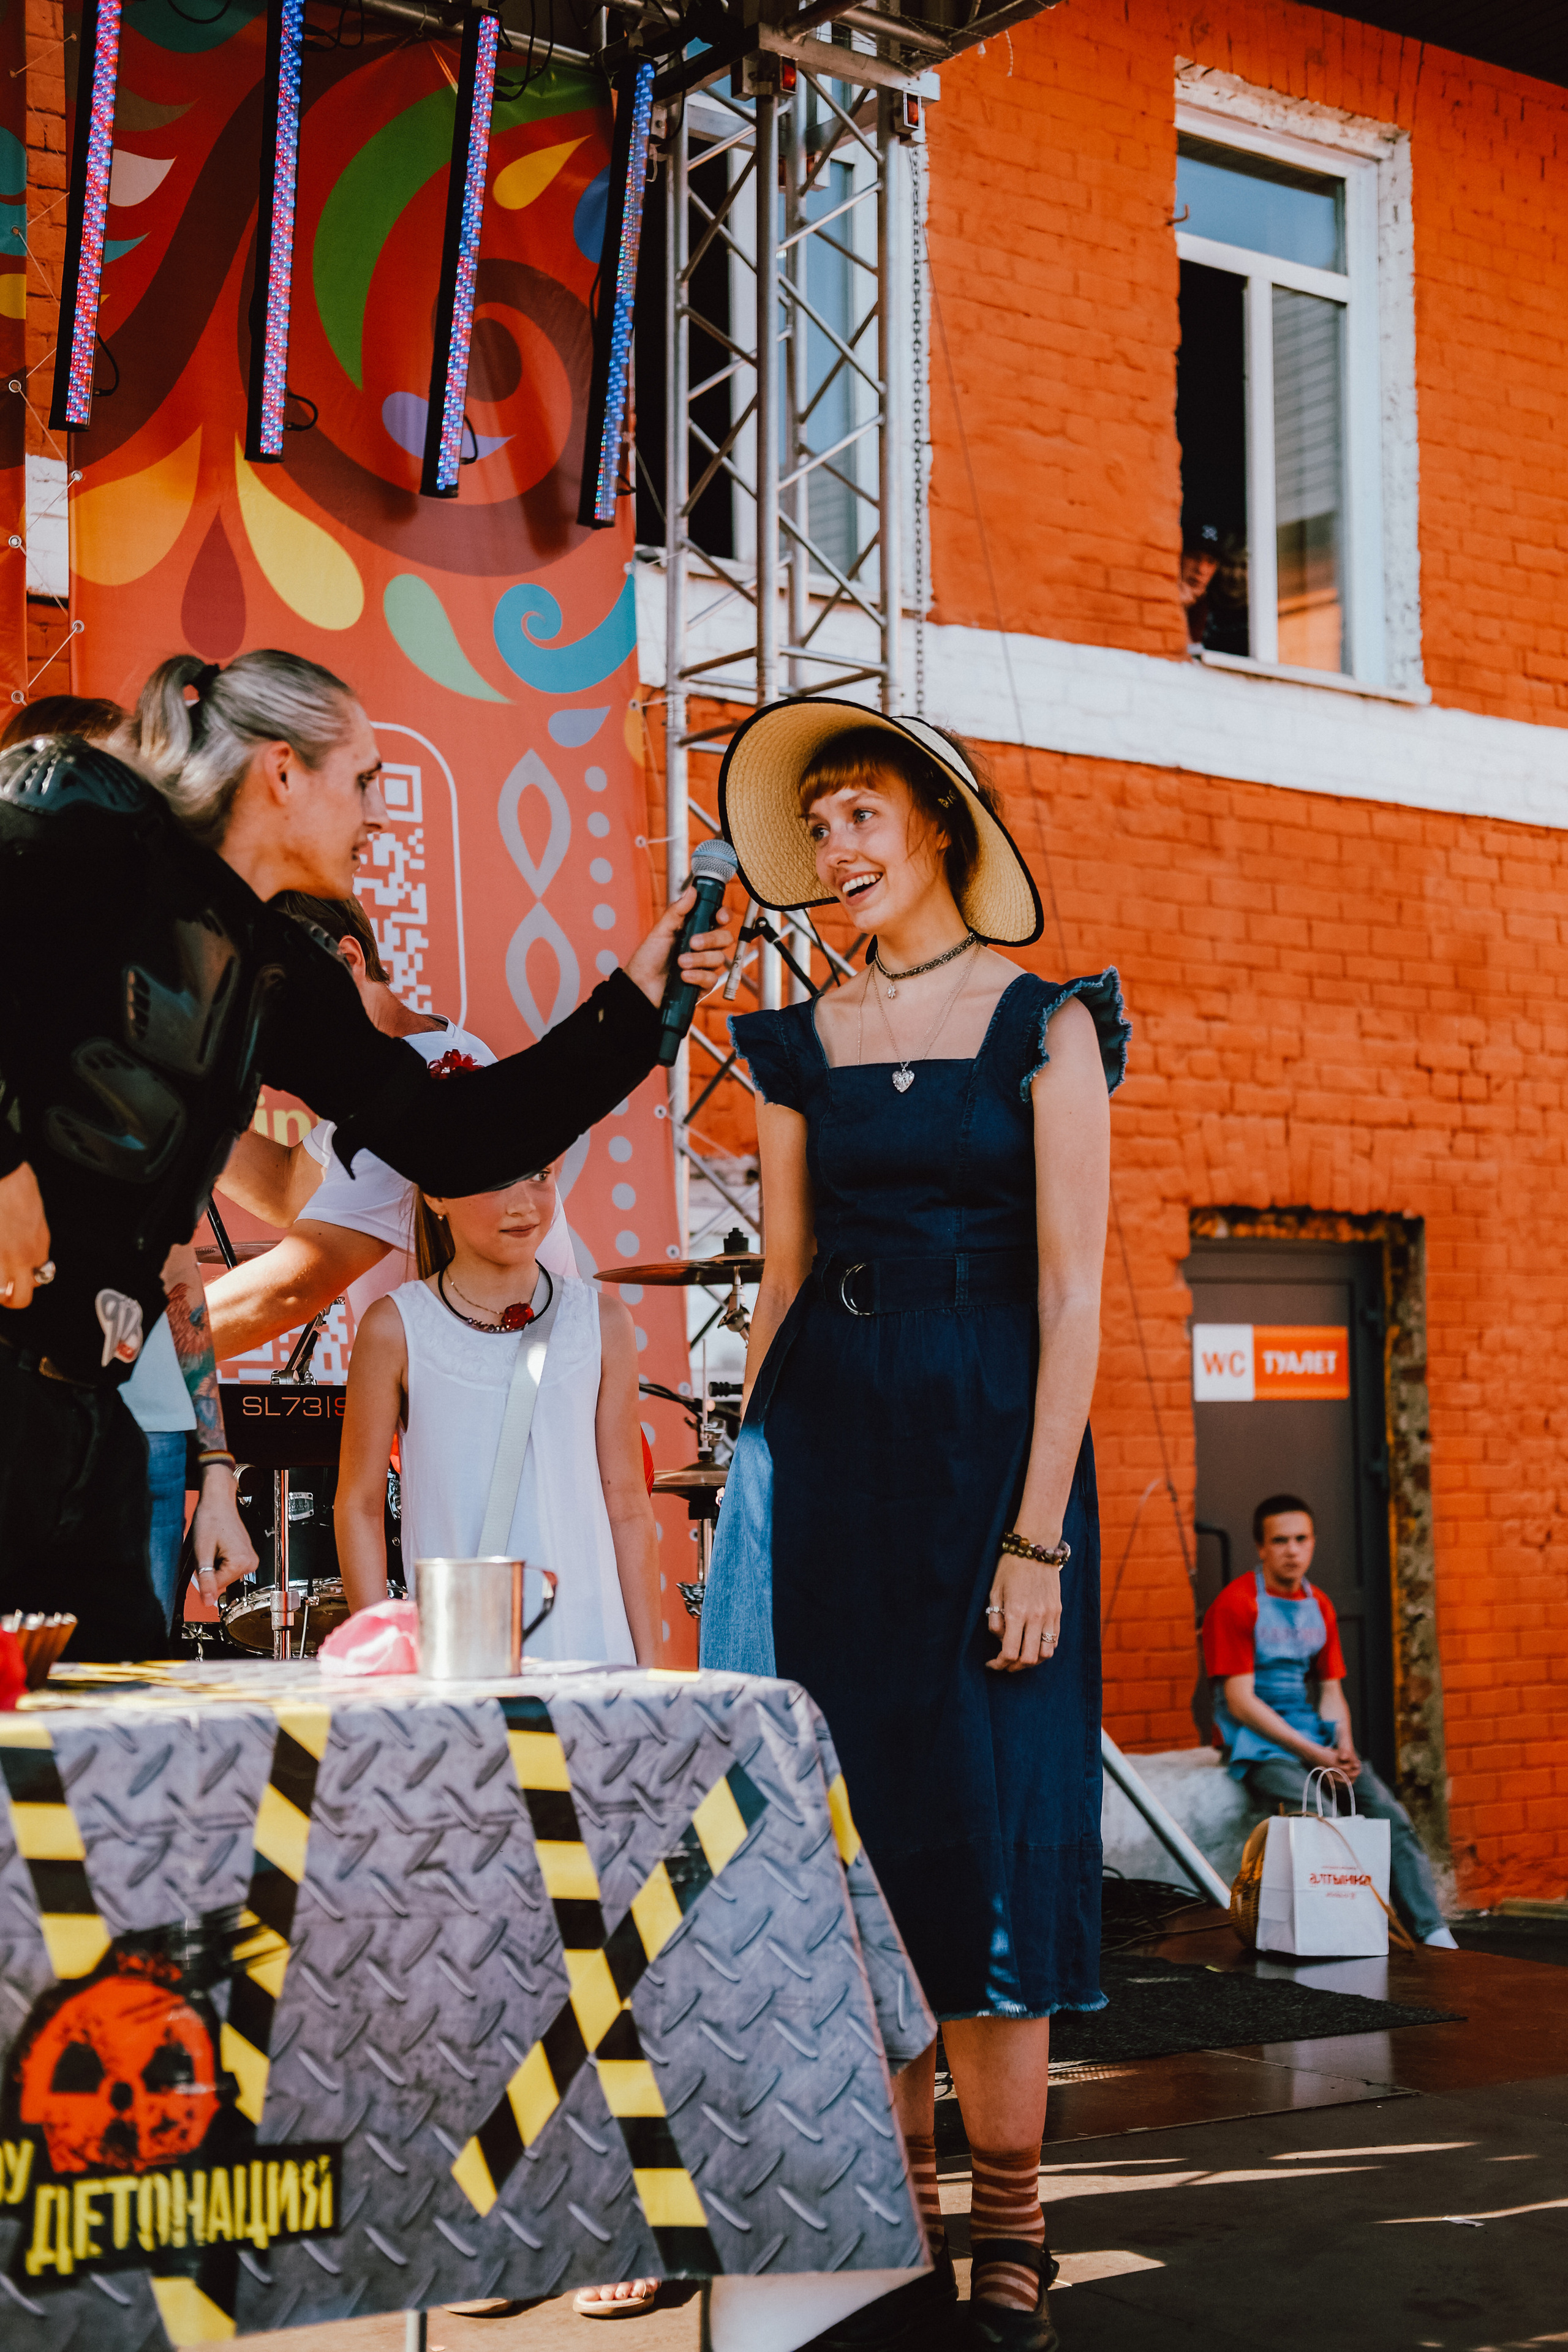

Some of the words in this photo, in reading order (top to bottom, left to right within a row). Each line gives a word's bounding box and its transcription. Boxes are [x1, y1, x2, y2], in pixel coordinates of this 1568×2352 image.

[1201, 1350, 1245, 1378] WC
[1262, 1350, 1338, 1374] ТУАЛЕТ
[0, 2138, 34, 2204] У
[26, 2154, 333, 2275] ДЕТОНАЦИЯ
